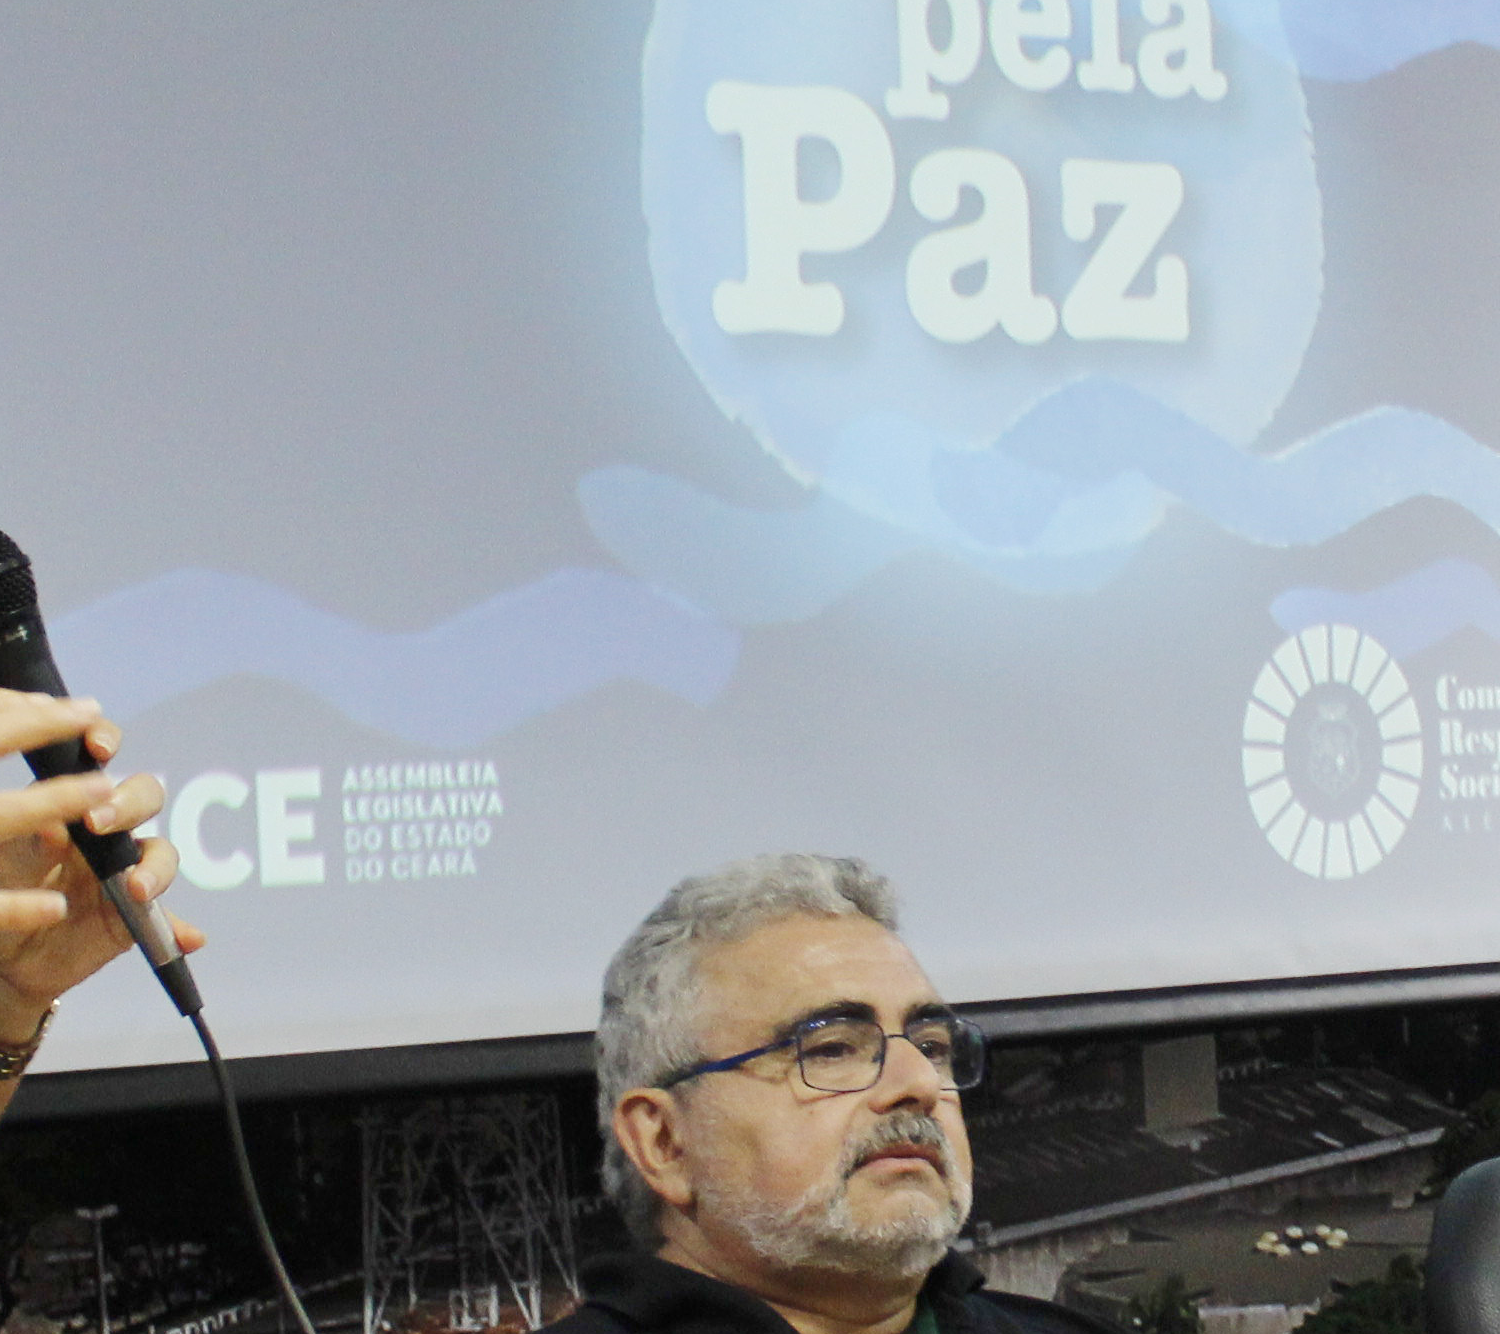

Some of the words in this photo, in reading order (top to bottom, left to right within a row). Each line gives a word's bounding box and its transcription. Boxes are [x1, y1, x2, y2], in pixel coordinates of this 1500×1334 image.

[704, 79, 1191, 344] Paz
[341, 761, 499, 792] ASSEMBLEIA
[342, 791, 504, 823] LEGISLATIVA
[345, 825, 383, 854] DO
[390, 819, 492, 851] ESTADO
[346, 855, 384, 883] DO
[390, 846, 478, 881] CEARÁ
